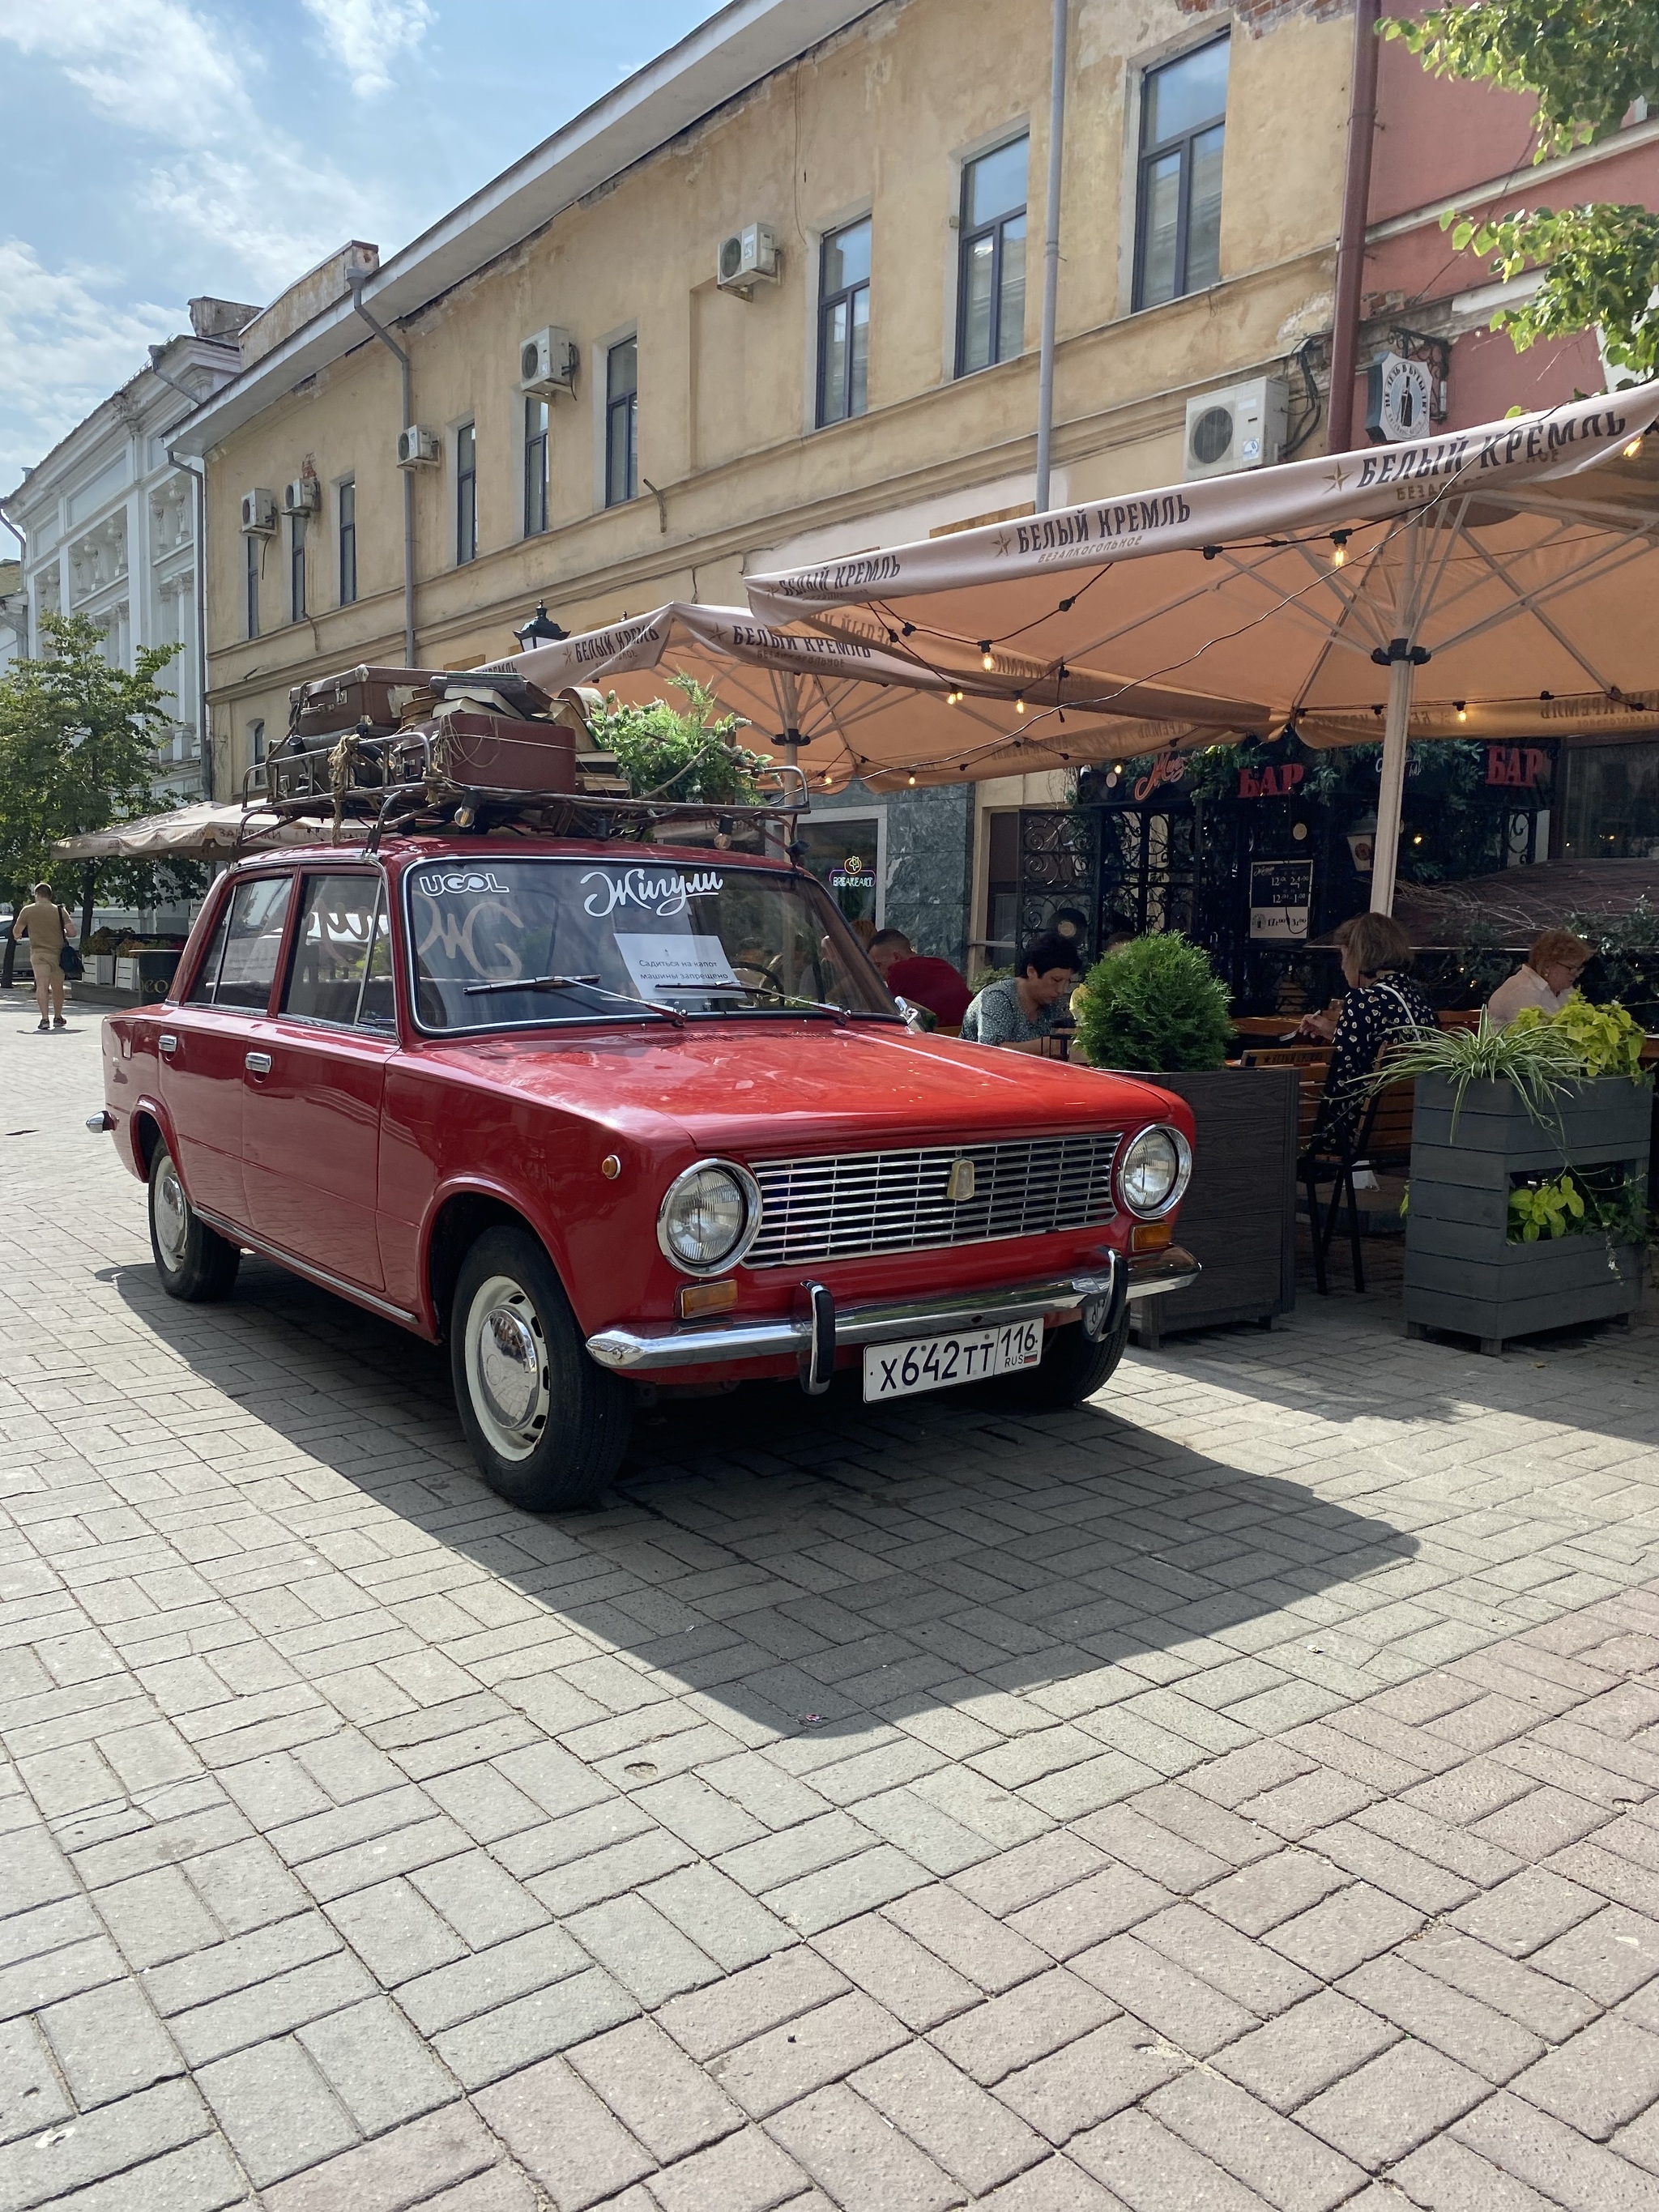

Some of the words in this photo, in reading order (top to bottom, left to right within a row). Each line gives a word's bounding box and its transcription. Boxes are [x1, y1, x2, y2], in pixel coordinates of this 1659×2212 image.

[1356, 437, 1470, 488] БЕЛЫЙ
[1479, 411, 1627, 469] КРЕМЛЬ
[1017, 508, 1090, 554] БЕЛЫЙ
[1097, 494, 1191, 539] КРЕМЛЬ
[1038, 535, 1143, 563] БЕЗАЛКОГОЛЬНОЕ
[778, 566, 831, 597] БЕЛЫЙ
[834, 555, 901, 590] КРЕМЛЬ
[574, 631, 616, 663] БЕЛЫЙ
[732, 624, 799, 650] БЕЛЫЙ
[1238, 763, 1304, 798] БАР
[1485, 745, 1544, 787] БАР
[418, 872, 509, 897] UGOL
[580, 868, 723, 917] Жигули
[639, 959, 680, 968] Садиться
[880, 1340, 996, 1392] Х642ТТ
[1000, 1323, 1036, 1357] 116
[1004, 1354, 1025, 1368] RUS
